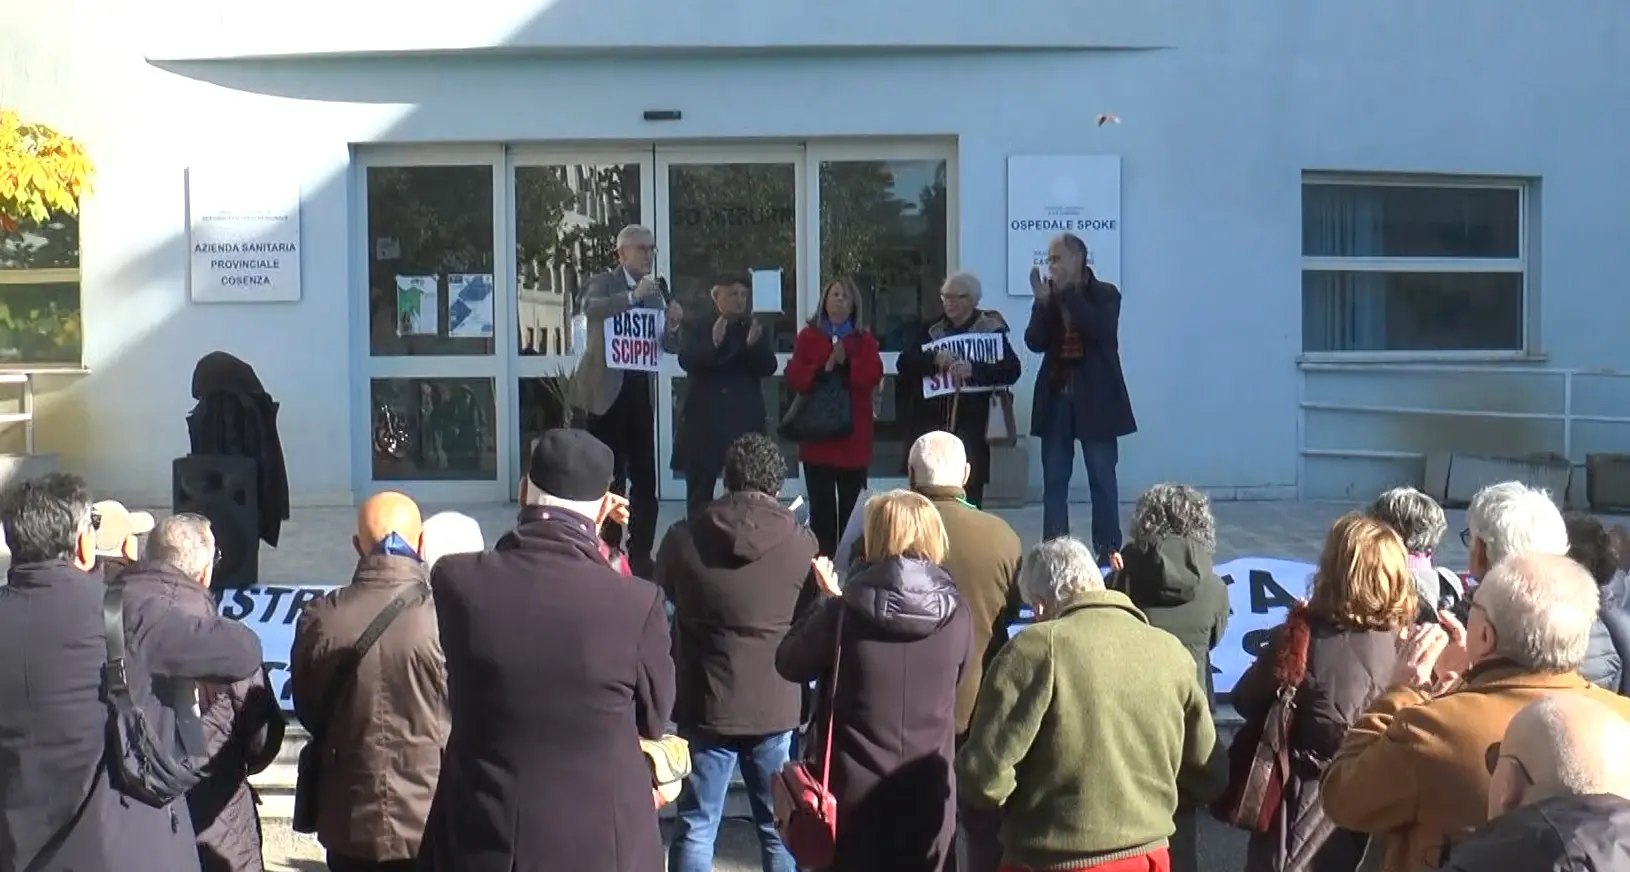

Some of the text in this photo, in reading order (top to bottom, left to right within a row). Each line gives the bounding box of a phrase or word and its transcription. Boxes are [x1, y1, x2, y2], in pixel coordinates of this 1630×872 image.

[1011, 219, 1117, 231] OSPEDALE SPOKE
[194, 242, 296, 254] AZIENDA SANITARIA
[210, 259, 280, 269] PROVINCIALE
[220, 275, 271, 286] COSENZA
[613, 312, 656, 339] BASTA
[611, 338, 658, 367] SCIPPI!
